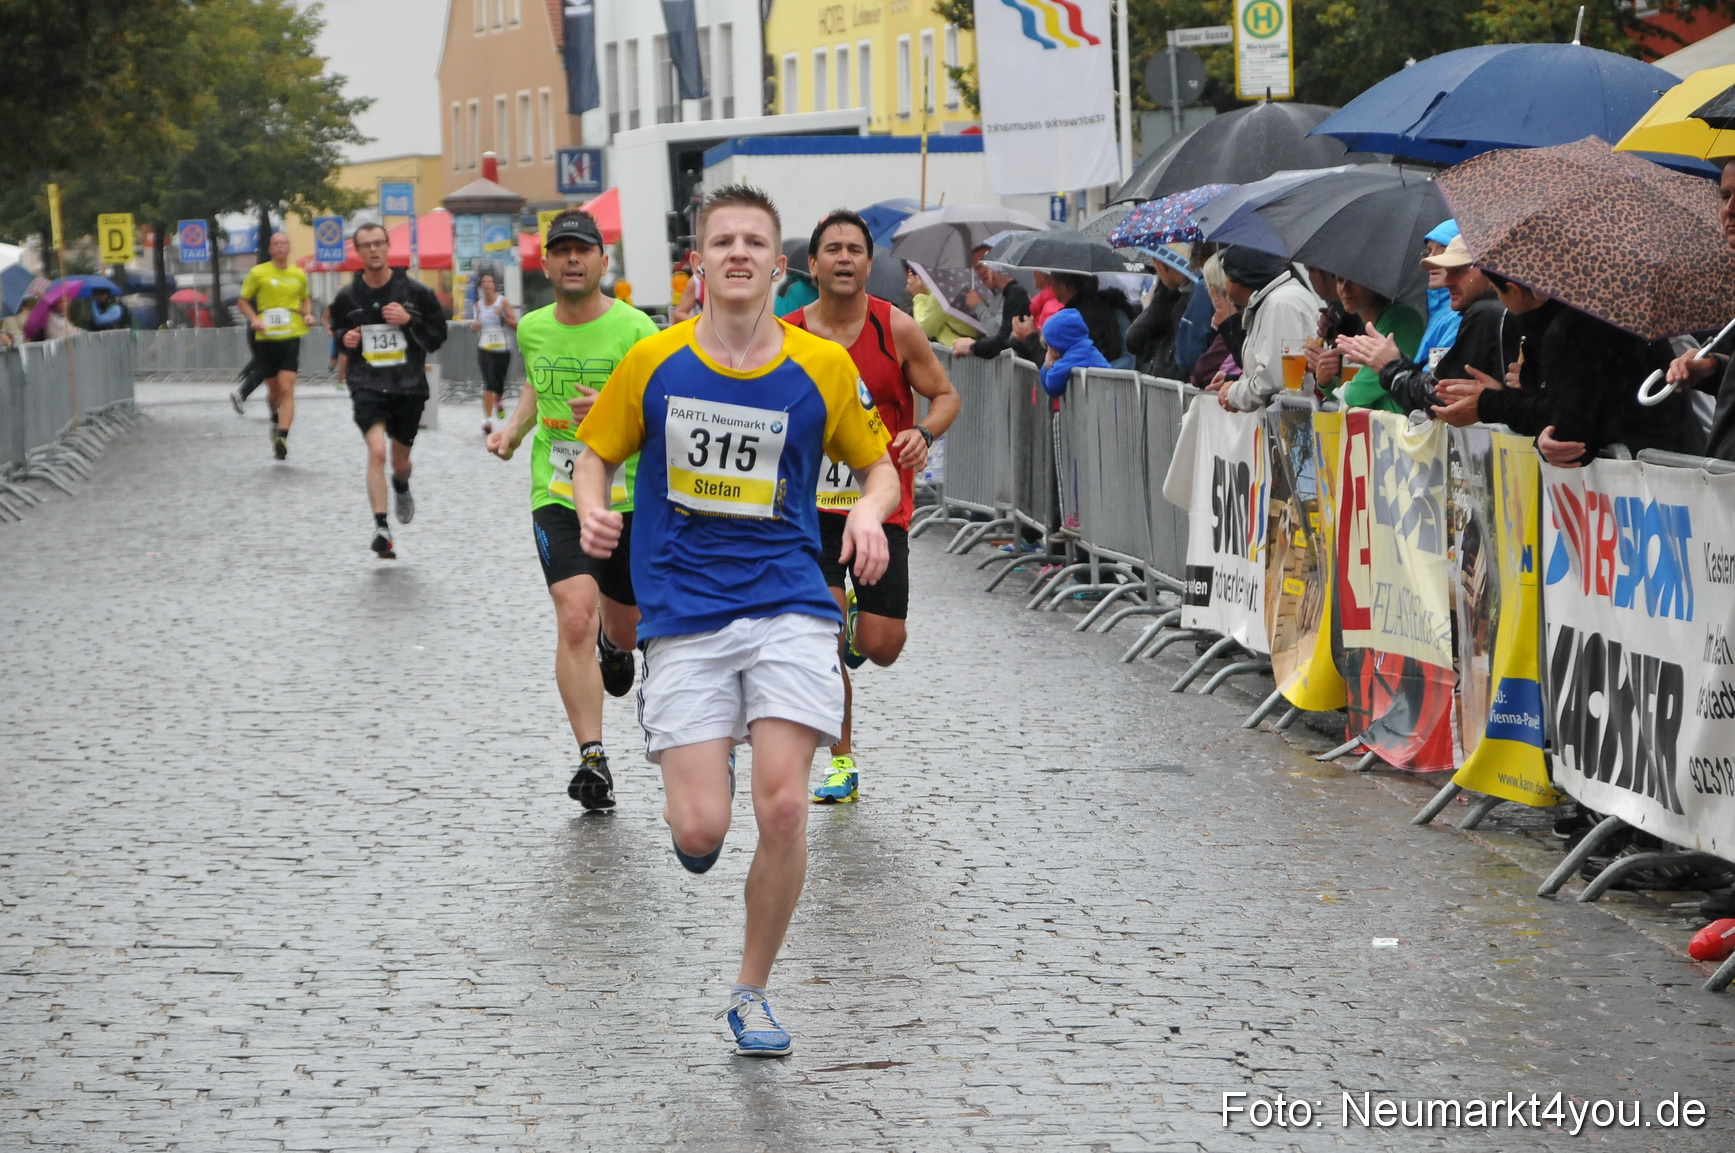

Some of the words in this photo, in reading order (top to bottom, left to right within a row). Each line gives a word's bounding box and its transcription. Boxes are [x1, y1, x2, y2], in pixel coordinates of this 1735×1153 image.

[1253, 7, 1272, 29] H
[1180, 32, 1200, 41] Ulmer
[1205, 30, 1229, 39] Gasse
[108, 229, 123, 251] D
[183, 248, 207, 258] TAXI
[318, 248, 342, 258] TAXI
[371, 333, 398, 349] 134
[670, 407, 709, 422] PARTL
[711, 413, 766, 431] Neumarkt
[552, 445, 572, 456] PARTL
[687, 427, 760, 472] 315
[693, 478, 741, 498] Stefan
[1689, 755, 1735, 797] 92318
